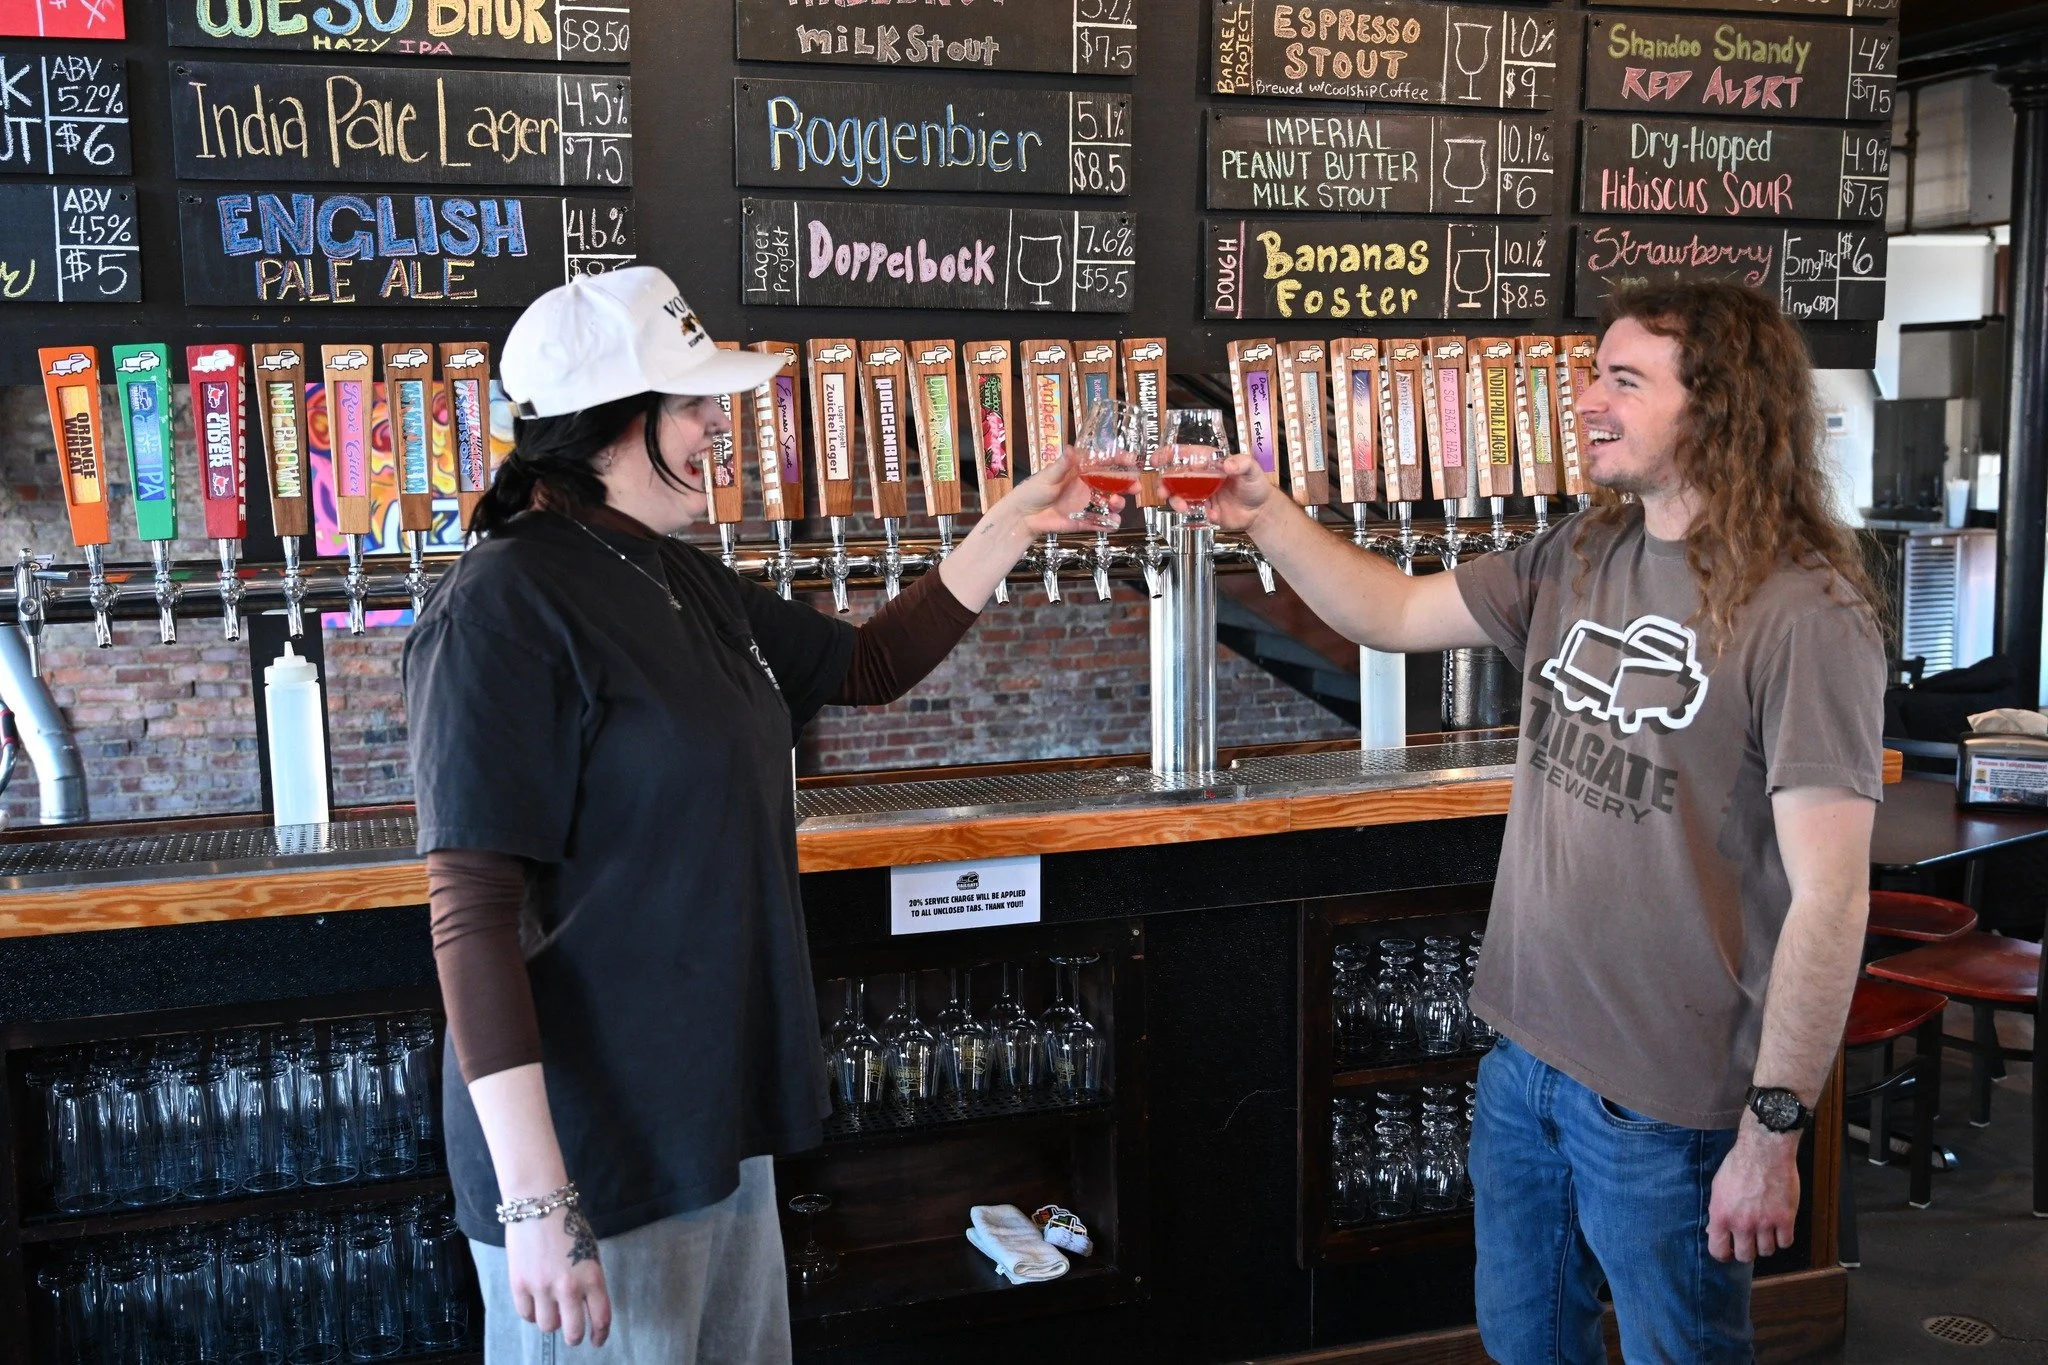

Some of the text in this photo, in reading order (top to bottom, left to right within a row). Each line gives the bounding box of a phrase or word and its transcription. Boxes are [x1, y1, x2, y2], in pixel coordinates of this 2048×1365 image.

[313, 34, 453, 55] HAZY IPA
[560, 17, 630, 52] $8.50
[1274, 4, 1421, 44] ESPRESSO
[1511, 17, 1555, 57] 10%
[1081, 28, 1132, 69] $7.5
[1217, 11, 1237, 94] BARREL
[1236, 4, 1252, 88] PROJECT
[1285, 43, 1408, 80] STOUT
[1607, 23, 1812, 75] Shandoo Shandy
[1858, 37, 1890, 71] 4%
[51, 56, 102, 82] ABV
[1621, 65, 1804, 110] RED ALERT
[57, 83, 122, 114] 5.2%
[564, 83, 627, 126] 4.5%
[1256, 81, 1304, 97] Brewed
[1379, 82, 1429, 101] Coffee
[1852, 76, 1891, 113] $7.5
[188, 75, 559, 168] India Pale Lager
[1077, 101, 1124, 140] 5.1%
[1266, 118, 1392, 150] IMPERIAL
[55, 123, 115, 165] $6
[565, 137, 623, 184] $7.5
[768, 95, 1042, 188] Roggenbier
[1503, 125, 1550, 164] 10.1%
[1631, 123, 1773, 172] Dry-Hopped
[1846, 139, 1888, 172] 4.9%
[1074, 148, 1126, 194] $8.5
[1222, 150, 1419, 183] PEANUT BUTTER
[63, 188, 112, 212] ABV
[1253, 182, 1393, 209] MILK STOUT
[1503, 174, 1537, 209] $6
[1601, 166, 1708, 215] Hibiscus
[1843, 176, 1883, 218] $7.5
[68, 215, 131, 244] 4.5%
[217, 193, 528, 262] ENGLISH
[567, 208, 627, 251] 4.6%
[1080, 225, 1133, 258] 7.6%
[62, 249, 128, 294] $5
[747, 225, 770, 293] Lager
[1256, 230, 1430, 280] Bananas
[1504, 239, 1544, 268] 10.1%
[1588, 226, 1773, 288] Strawberry
[1841, 233, 1873, 275] $6
[255, 258, 478, 303] PALE ALE
[1077, 265, 1129, 299] $5.5
[1215, 238, 1238, 311] DOUGH
[1276, 279, 1419, 318] Foster
[1502, 282, 1547, 315] $8.5
[837, 405, 845, 426] Lager
[1444, 389, 1455, 403] SO
[1489, 368, 1507, 464] INDIA PALE LAGER
[206, 413, 223, 468] CIDER
[219, 412, 231, 468] TAILGATE
[238, 362, 247, 522] TAILGATE
[269, 382, 302, 498] NUT BROWN
[825, 384, 838, 474] Zwickel Lager
[874, 377, 900, 482] ROGGENBIER
[1445, 408, 1457, 435] BACK
[64, 417, 84, 477] WHEAT
[76, 412, 97, 479] ORANGE
[1447, 440, 1459, 466] HAZY
[138, 463, 166, 500] IPA
[345, 440, 364, 493] Cider
[909, 899, 923, 907] 20%
[925, 896, 950, 906] SERVICE
[951, 894, 975, 903] CHARGE
[976, 892, 990, 901] WILL
[1001, 889, 1026, 898] APPLIED
[921, 908, 931, 917] ALL
[933, 905, 965, 915] UNCLOSED
[966, 903, 984, 913] TABS.
[985, 901, 1005, 910] THANK
